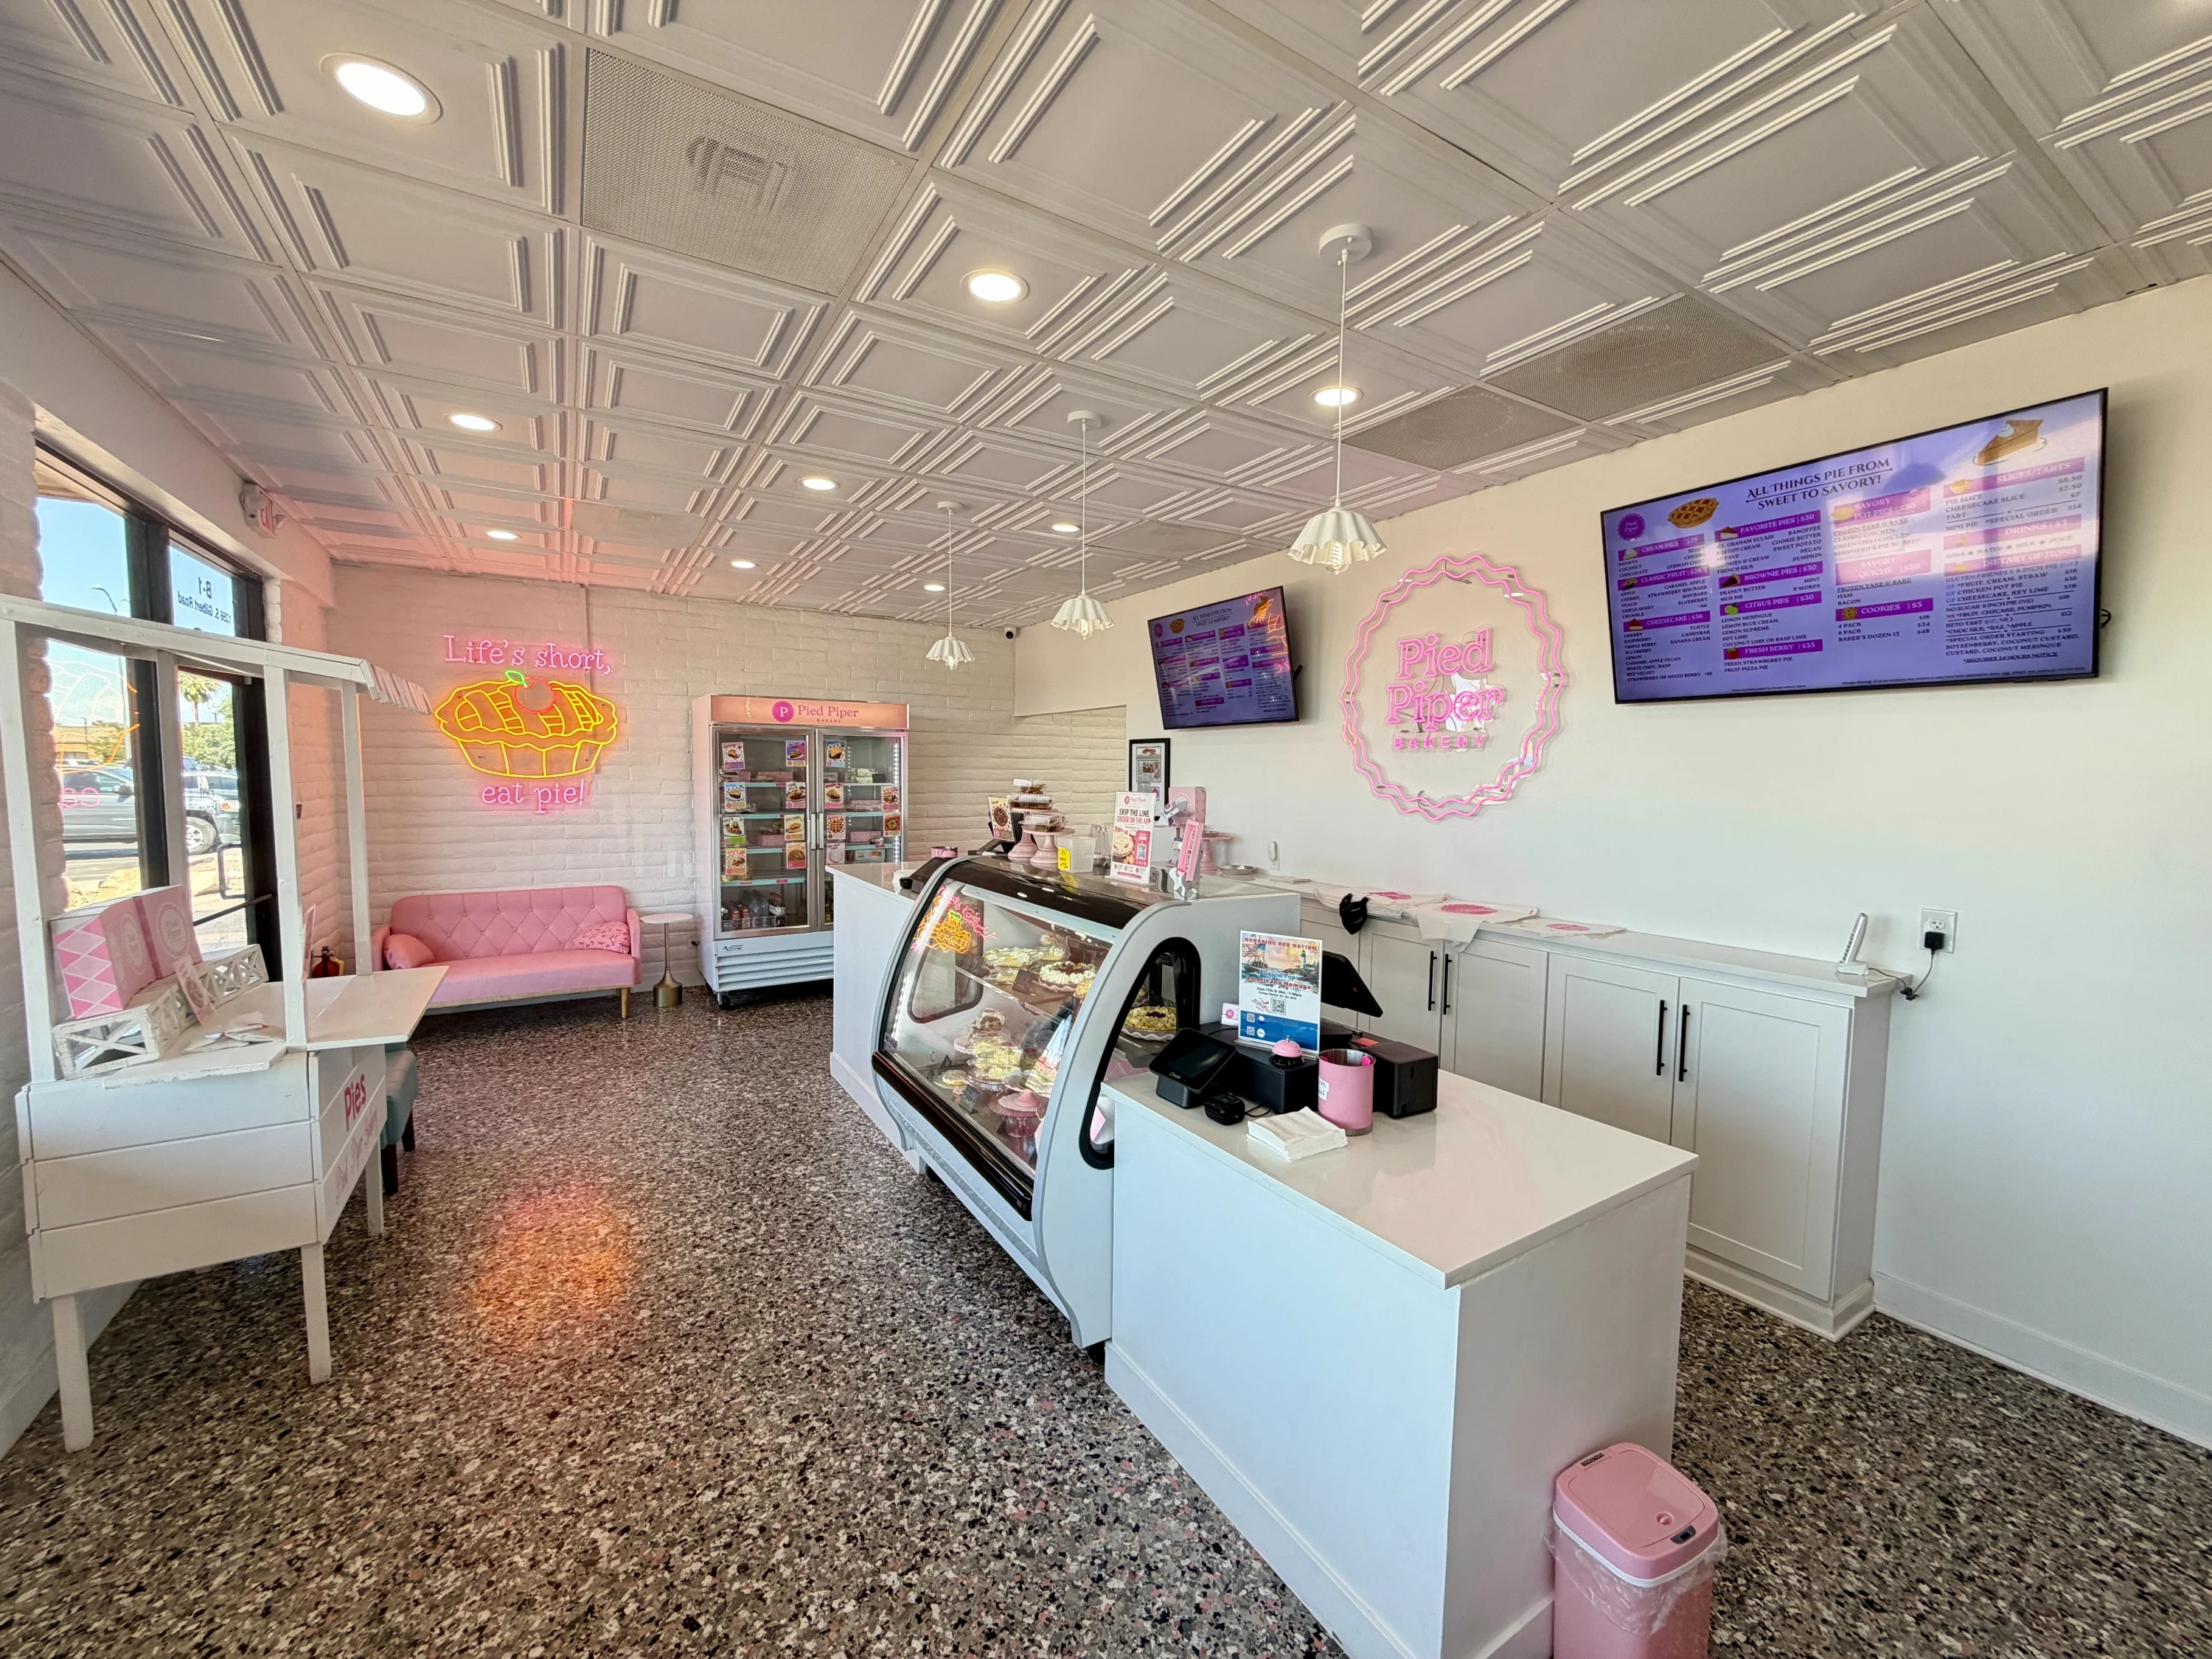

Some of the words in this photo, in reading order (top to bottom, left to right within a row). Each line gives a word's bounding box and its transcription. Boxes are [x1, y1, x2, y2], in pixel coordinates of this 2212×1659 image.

[1747, 484, 1769, 500] ALL
[1770, 472, 1820, 493] THINGS
[1823, 467, 1845, 481] PIE
[1848, 456, 1890, 476] FROM
[1996, 462, 2072, 484] SLICES/TARTS
[1757, 492, 1798, 510] SWEET
[1799, 487, 1819, 501] TO
[1821, 473, 1881, 497] SAVORY!
[1854, 497, 1891, 510] SAVORY
[1945, 497, 1959, 506] PIE
[1960, 493, 1983, 503] SLICE
[1945, 497, 2000, 513] CHEESECAKE
[2000, 493, 2025, 503] SLICE
[1854, 509, 1873, 520] POT
[1873, 506, 1893, 516] PIES
[1944, 511, 1966, 521] TART
[1944, 523, 1964, 532] MINI
[2026, 507, 2058, 518] ORDER
[1739, 521, 1778, 534] FAVORITE
[1778, 517, 1795, 526] PIES
[1800, 512, 1815, 522] $30
[2005, 522, 2047, 535] DRINKS
[1726, 538, 1752, 547] GRAHAM
[1753, 533, 1774, 543] ECLAIR
[1771, 536, 1795, 546] COOKIE
[1795, 532, 1821, 541] BUTTER
[1773, 543, 1794, 552] SWEET
[1795, 538, 1821, 548] POTATO
[1641, 543, 1665, 553] CREAM
[1664, 540, 1678, 549] PIES
[1739, 543, 1761, 552] CREAM
[1800, 545, 1821, 554] PECAN
[1747, 554, 1770, 563] CREAM
[1792, 552, 1822, 562] PUMPKIN
[1982, 554, 2027, 567] DIETARY
[2028, 546, 2077, 560] OPTIONS
[1640, 573, 1666, 583] CLASSIC
[1666, 569, 1686, 578] FRUIT
[1744, 569, 1780, 581] BROWNIE
[1780, 566, 1798, 575] PIES
[1802, 563, 1817, 572] $30
[1945, 574, 1975, 583] GLUTEN
[2017, 571, 2048, 581] STRAW
[1663, 581, 1688, 590] CARAMEL
[1719, 588, 1742, 596] PEANUT
[1742, 584, 1766, 592] BUTTER
[1792, 582, 1820, 591] S'MORES
[1837, 584, 1865, 593] FROZEN
[1865, 581, 1885, 589] TAKE
[1892, 577, 1912, 585] BAKE
[1956, 585, 1992, 596] CHICKEN
[1992, 583, 2009, 591] POT
[2028, 585, 2049, 594] LIME
[1745, 599, 1771, 609] CITRUS
[1772, 597, 1790, 605] PIES
[1799, 594, 1814, 602] $30
[1837, 598, 1861, 606] BACON
[1860, 603, 1901, 614] COOKIES
[1911, 601, 1923, 609] $5
[1646, 615, 1688, 625] CHEESECAKE
[1742, 612, 1773, 620] MERINGUE
[1681, 629, 1710, 637] CANDYBAR
[1837, 634, 1866, 642] BAKER'S
[1722, 639, 1750, 647] COCONUT
[2000, 636, 2039, 645] COCONUT
[1397, 627, 1492, 680] Pied
[1744, 646, 1769, 654] FRESH
[1769, 643, 1794, 652] BERRY
[1801, 641, 1815, 649] $35
[1981, 645, 2019, 653] COCONUT
[443, 634, 526, 667] Life's
[535, 642, 613, 677] short,
[1742, 657, 1782, 665] STRAWBERRY
[779, 706, 789, 717] P
[798, 705, 824, 716] Pied
[827, 706, 859, 718] Piper
[1385, 680, 1504, 732] Piper
[1393, 734, 1486, 750] BAKERY
[481, 782, 524, 804] eat
[533, 779, 585, 813] pie!
[1139, 810, 1150, 818] LINE
[1244, 937, 1276, 946] HONORING
[1292, 943, 1317, 951] NATION
[1245, 975, 1282, 986] Americana
[1284, 980, 1312, 991] Homage
[1284, 973, 1301, 981] Pops
